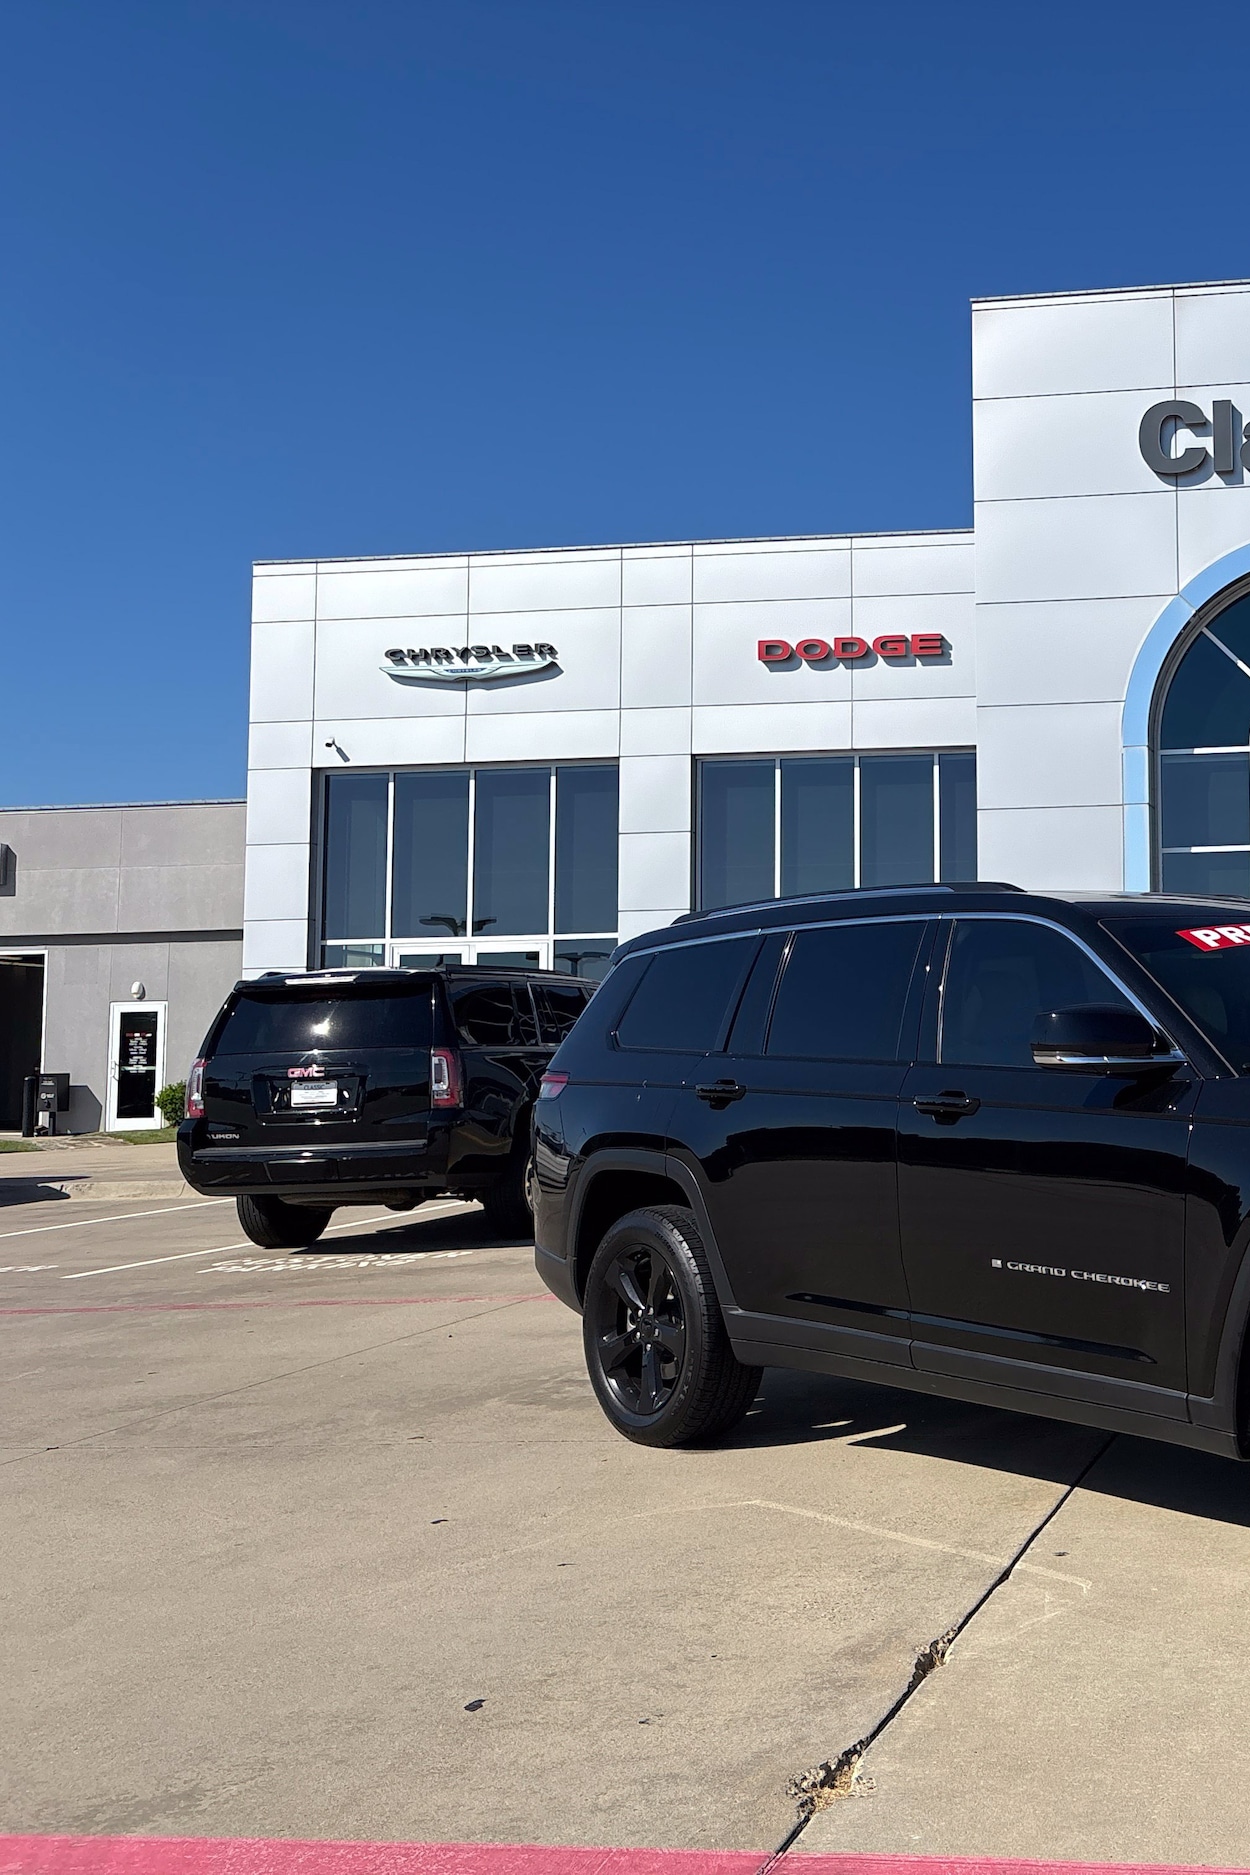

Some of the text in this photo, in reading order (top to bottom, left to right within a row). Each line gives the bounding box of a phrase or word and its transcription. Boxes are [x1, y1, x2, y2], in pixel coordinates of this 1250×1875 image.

[384, 643, 554, 662] CHRYSLER
[758, 633, 942, 661] DODGE
[287, 1066, 325, 1078] GMC
[1006, 1260, 1171, 1293] GRAND CHEROKEE
